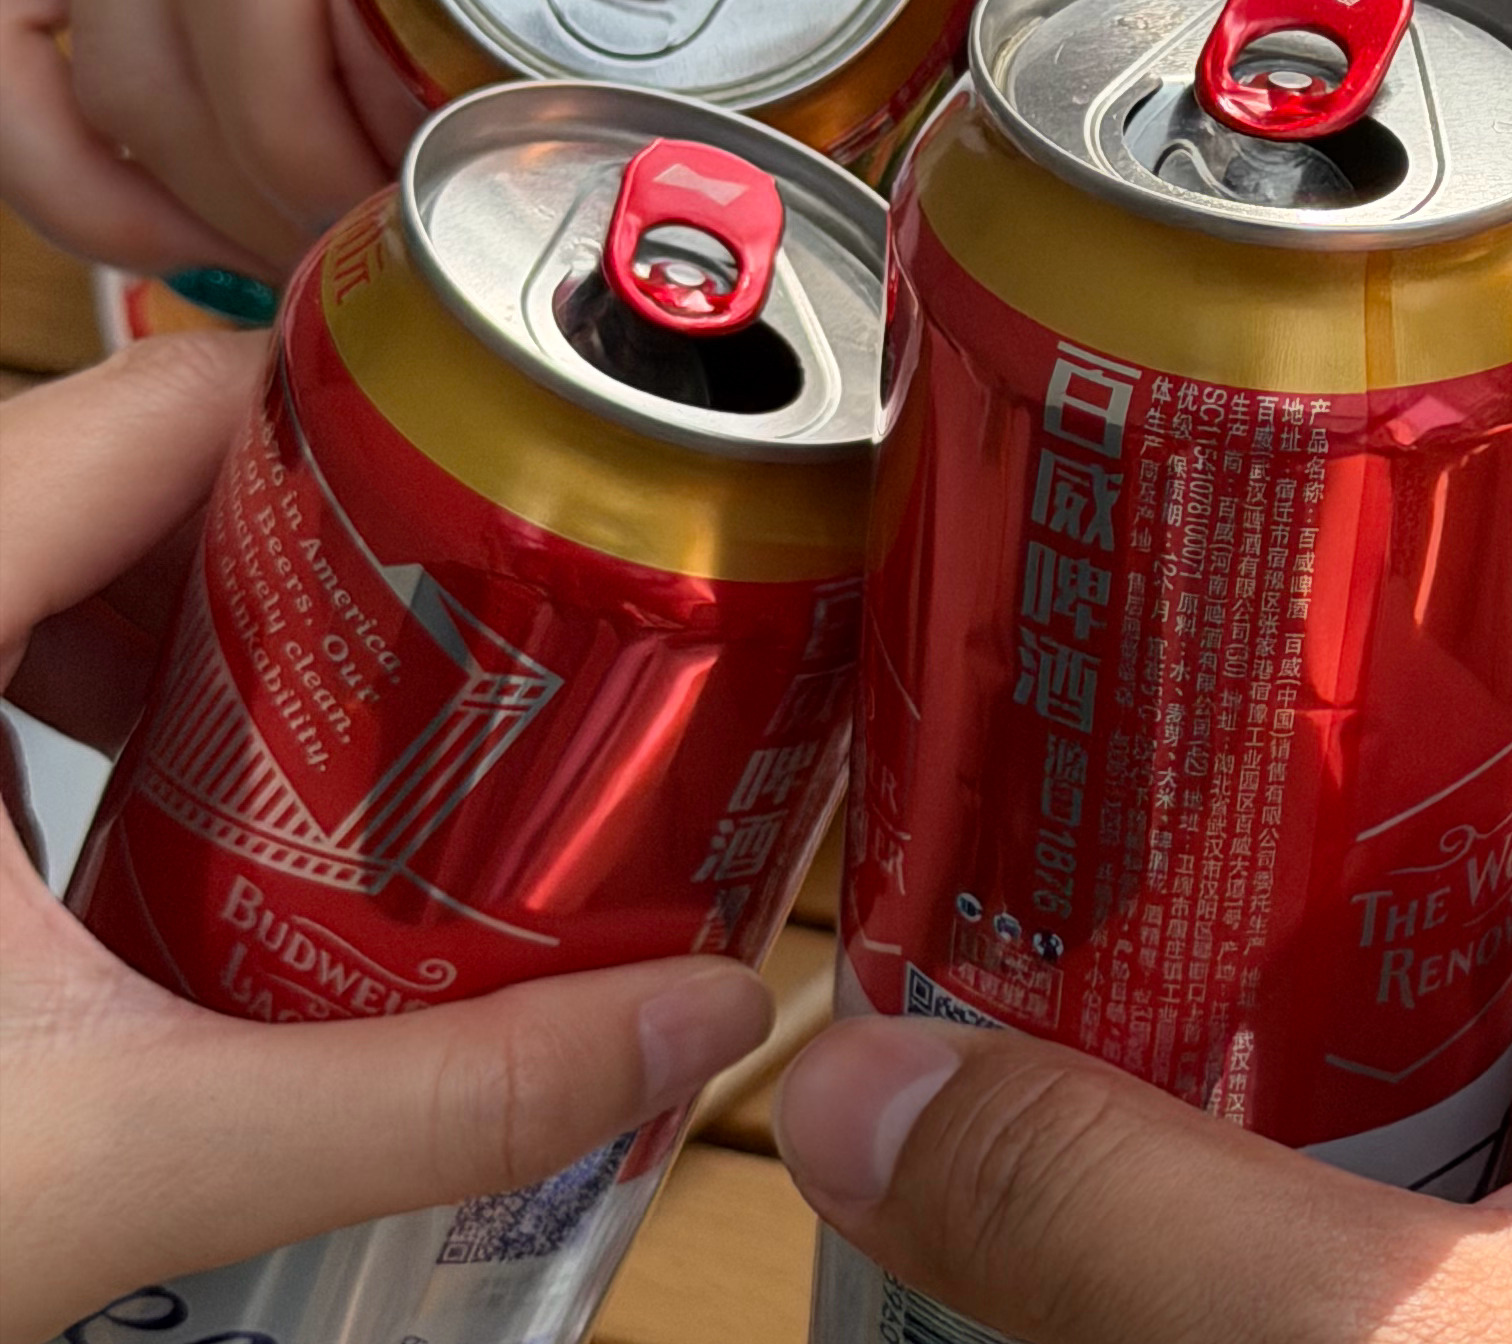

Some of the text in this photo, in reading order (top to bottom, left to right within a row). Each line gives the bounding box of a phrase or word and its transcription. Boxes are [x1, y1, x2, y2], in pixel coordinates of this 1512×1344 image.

[245, 459, 381, 704] of Beers. Our
[281, 492, 304, 532] in
[300, 535, 402, 685] America,
[1012, 341, 1142, 734] 百威啤酒
[221, 556, 328, 774] drinkability.
[285, 640, 352, 745] clean,
[1351, 885, 1451, 948] THE
